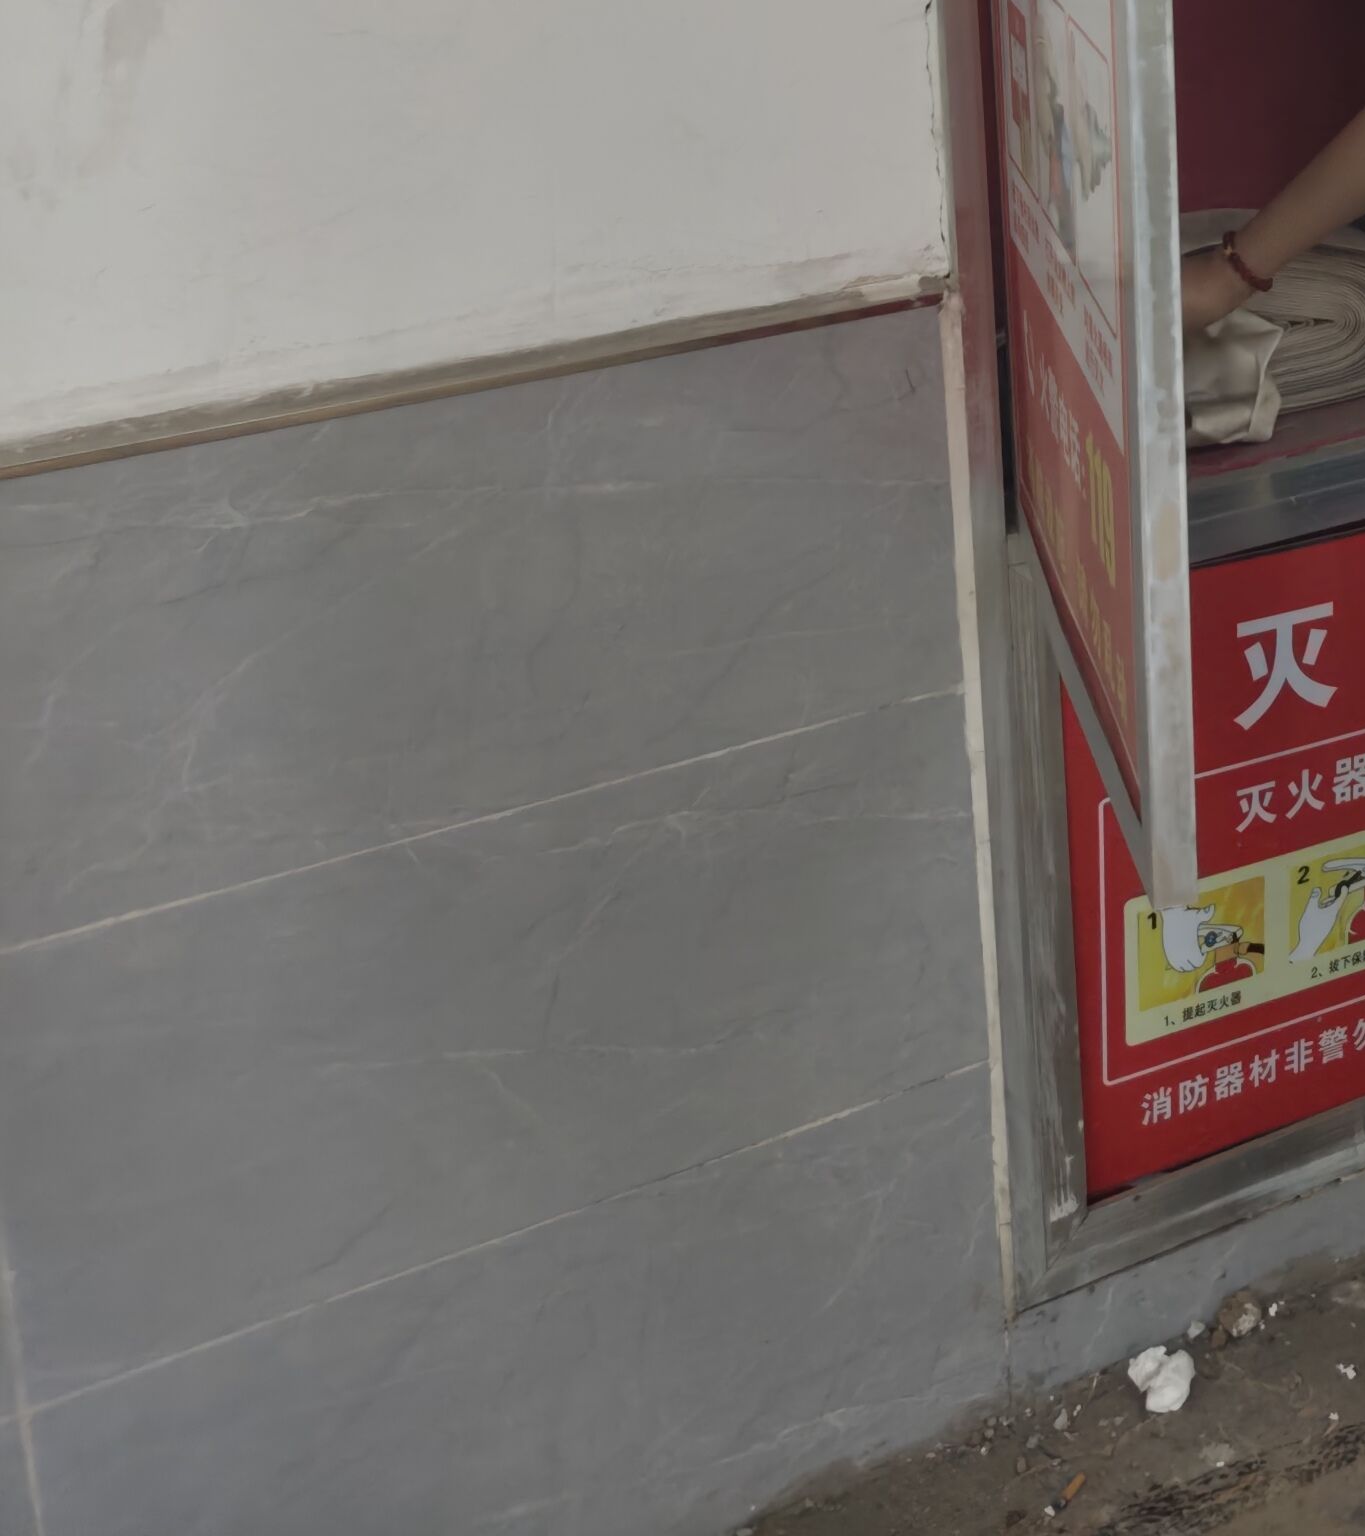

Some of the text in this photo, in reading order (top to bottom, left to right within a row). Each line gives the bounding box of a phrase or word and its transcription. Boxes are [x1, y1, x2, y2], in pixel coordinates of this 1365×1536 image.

[1296, 865, 1311, 885] 2
[1147, 912, 1158, 930] 1
[1164, 990, 1242, 1027] 1、提起灭火器
